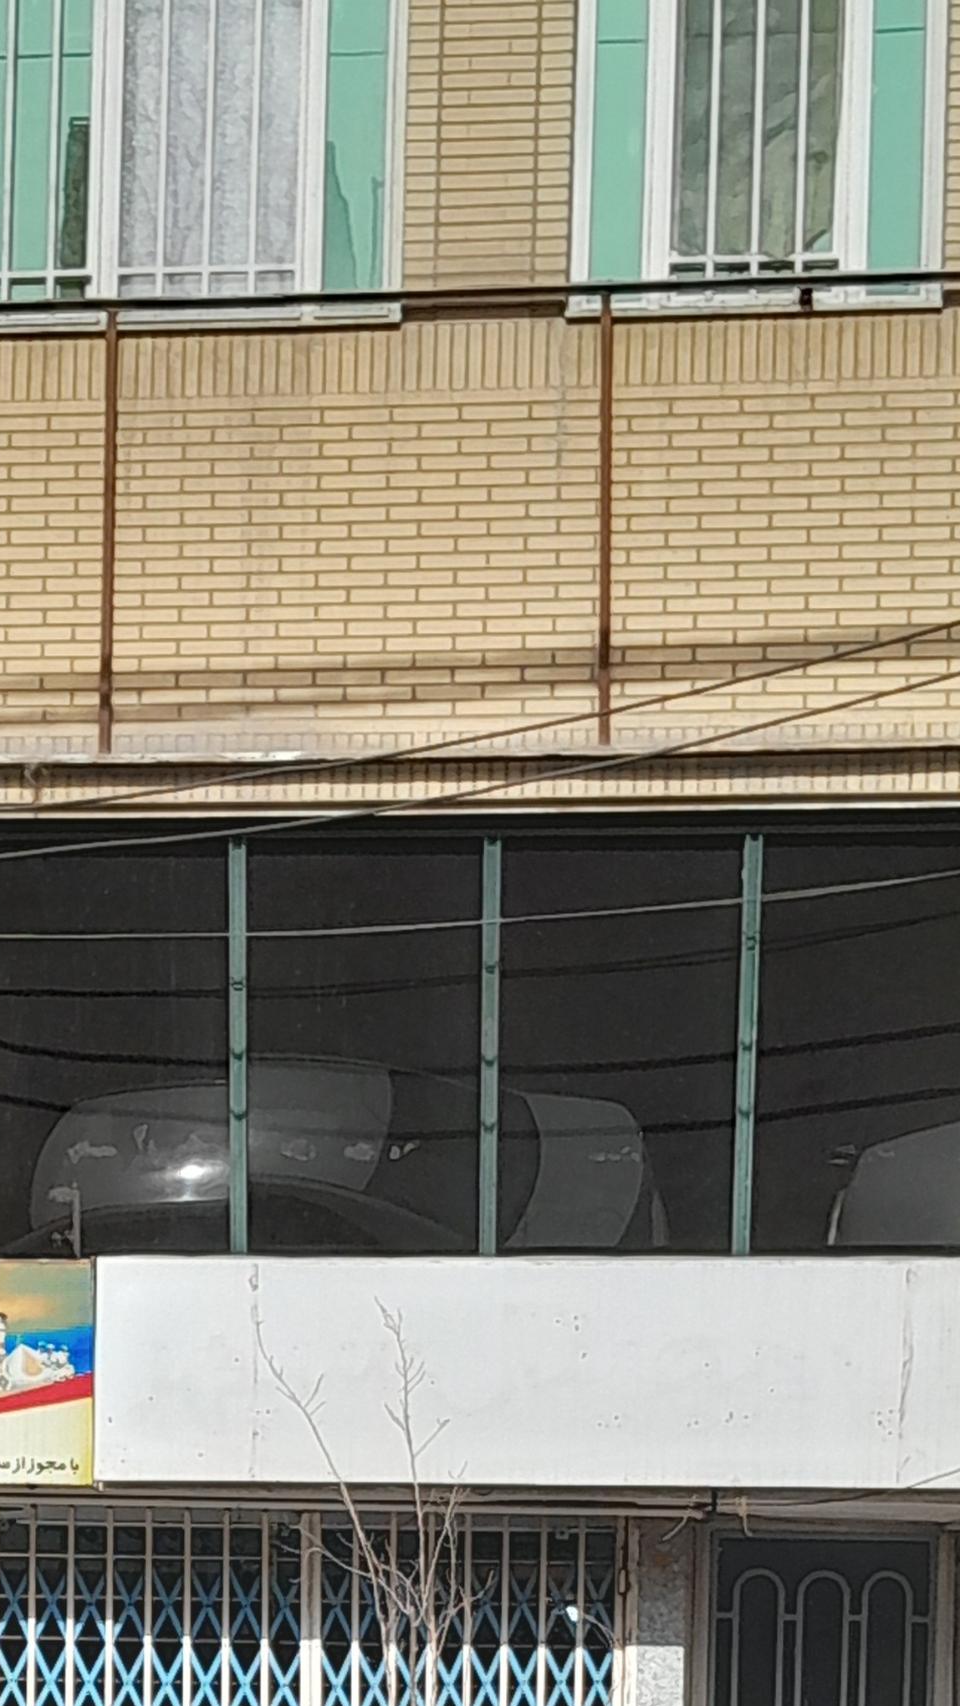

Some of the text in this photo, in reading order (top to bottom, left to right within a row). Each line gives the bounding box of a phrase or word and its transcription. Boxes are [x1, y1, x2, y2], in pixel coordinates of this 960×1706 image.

[12, 1456, 26, 1474] از
[27, 1458, 67, 1475] مجوز
[69, 1457, 80, 1475] با
